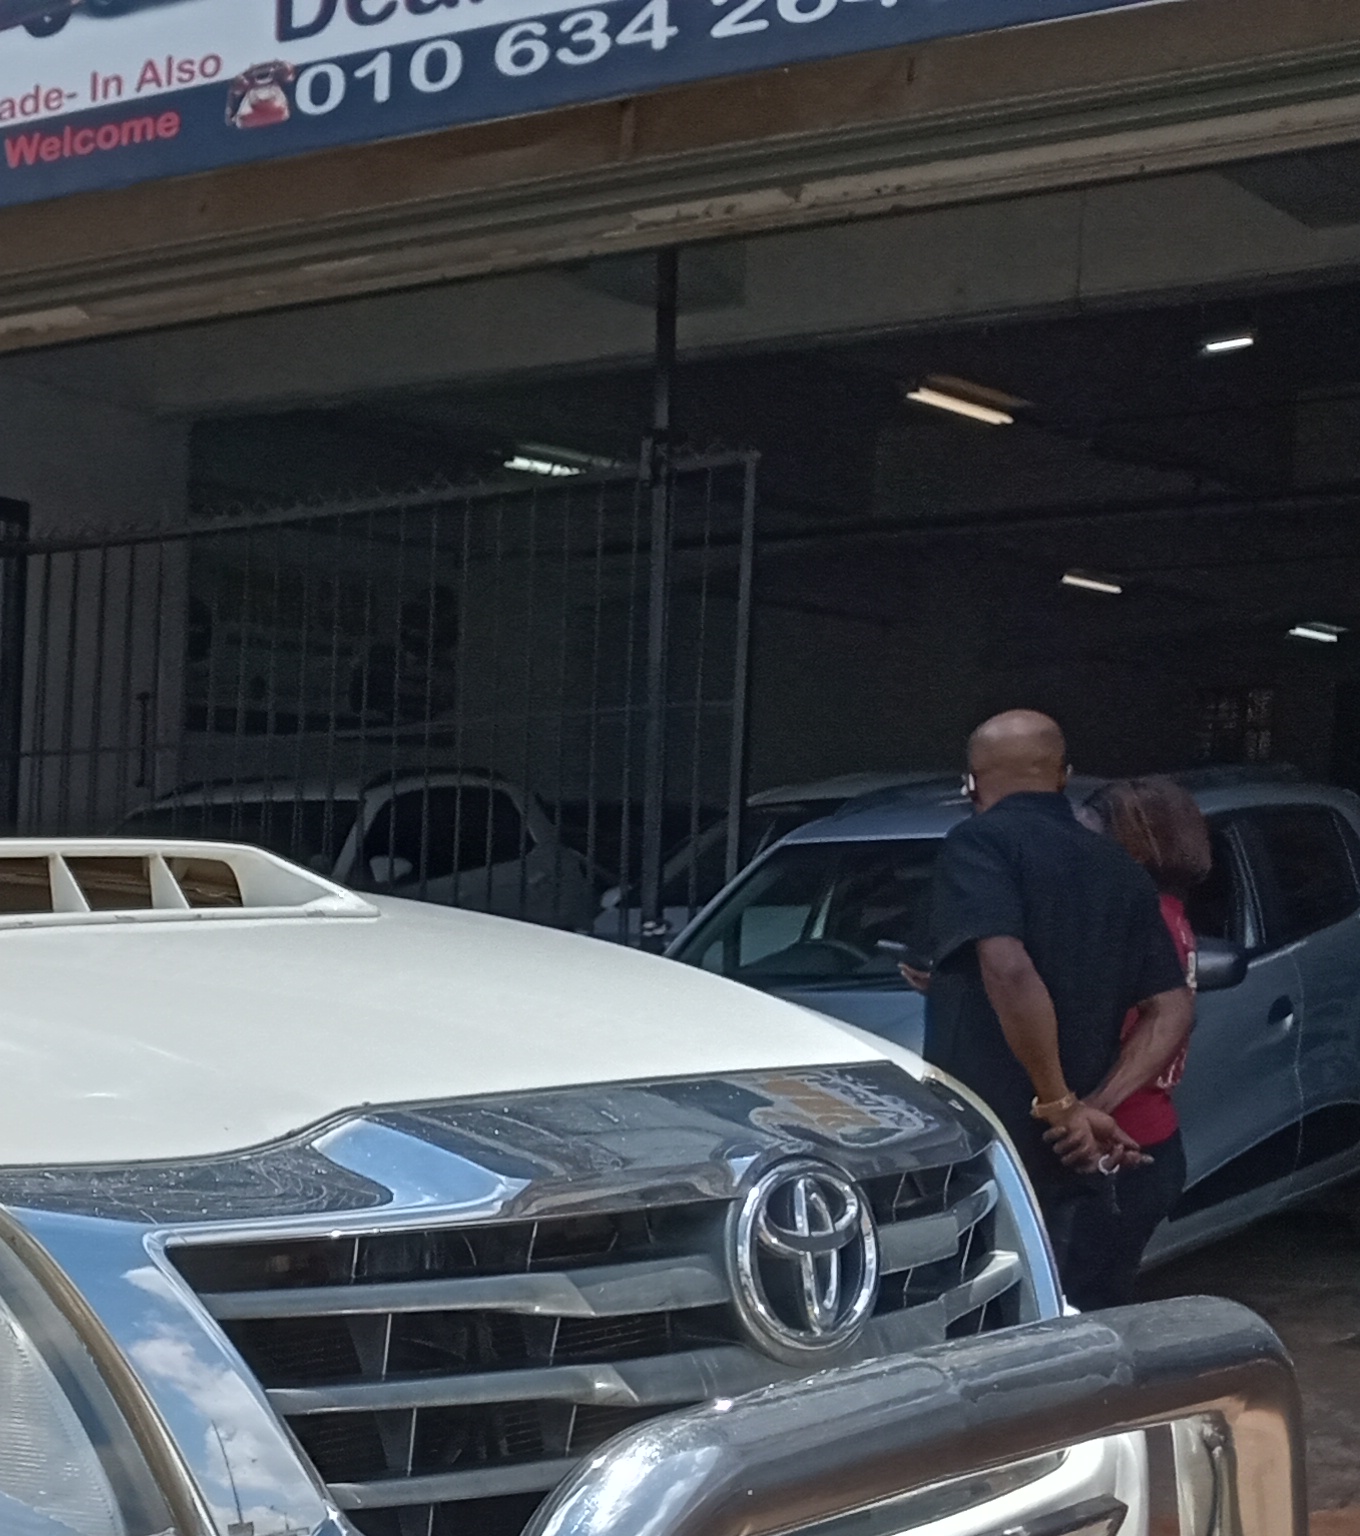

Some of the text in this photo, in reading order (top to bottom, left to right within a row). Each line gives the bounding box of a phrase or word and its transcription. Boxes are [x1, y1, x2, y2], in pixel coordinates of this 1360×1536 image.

[90, 70, 124, 103] In
[135, 53, 222, 93] Also
[295, 38, 463, 117] 010
[493, 0, 680, 78] 634
[4, 109, 181, 169] Welcome
